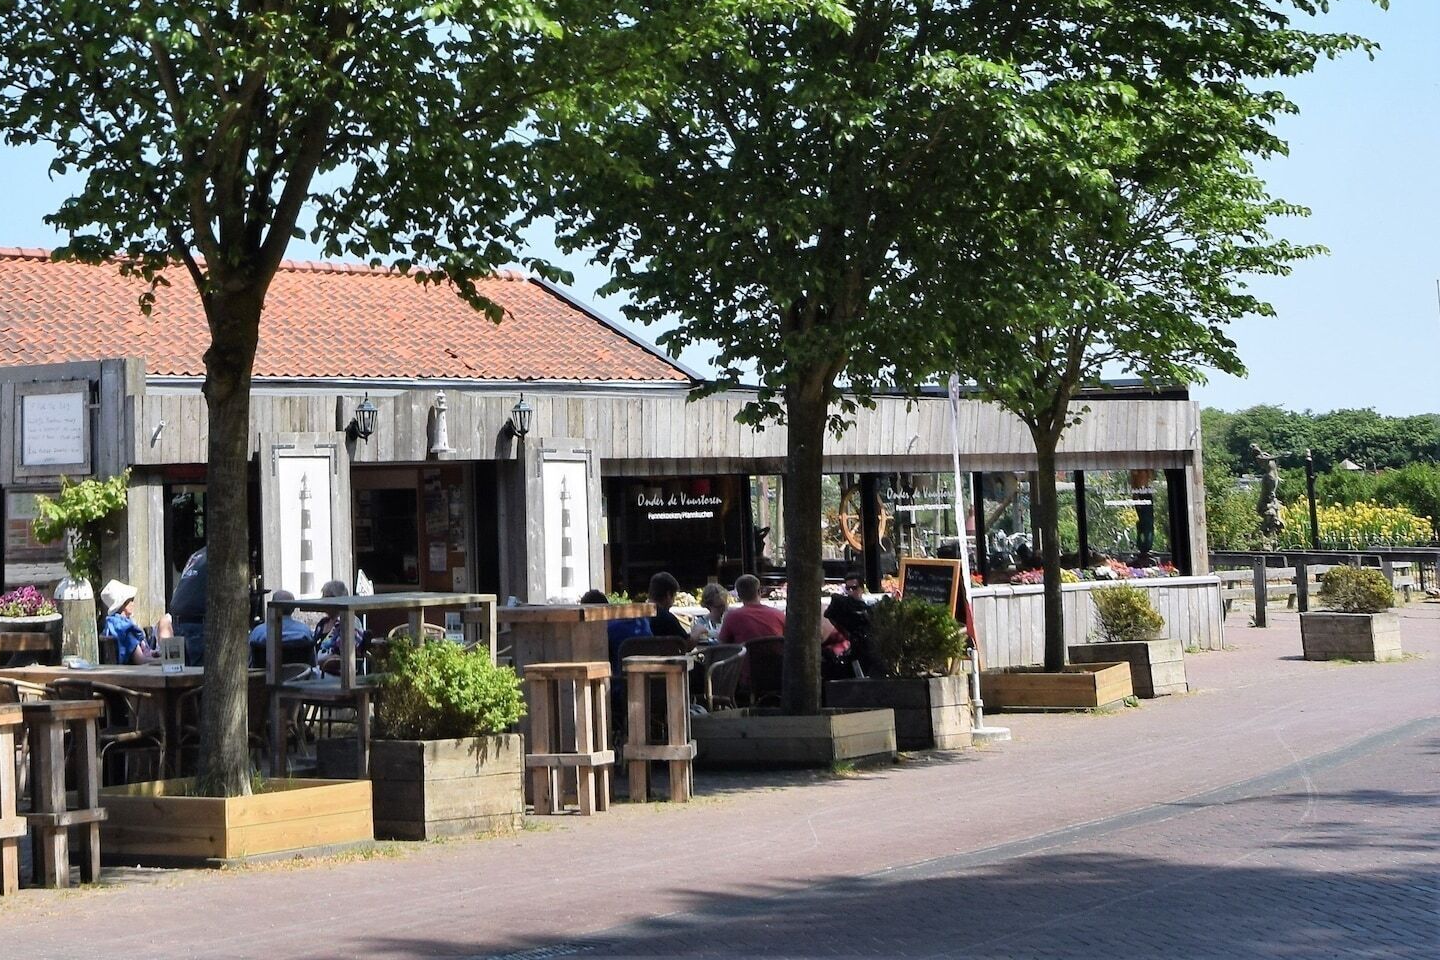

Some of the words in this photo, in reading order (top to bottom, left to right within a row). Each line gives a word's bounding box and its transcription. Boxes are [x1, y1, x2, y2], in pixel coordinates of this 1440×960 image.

[637, 493, 664, 507] Onder
[668, 493, 677, 506] de
[680, 491, 723, 506] Vuurtoren
